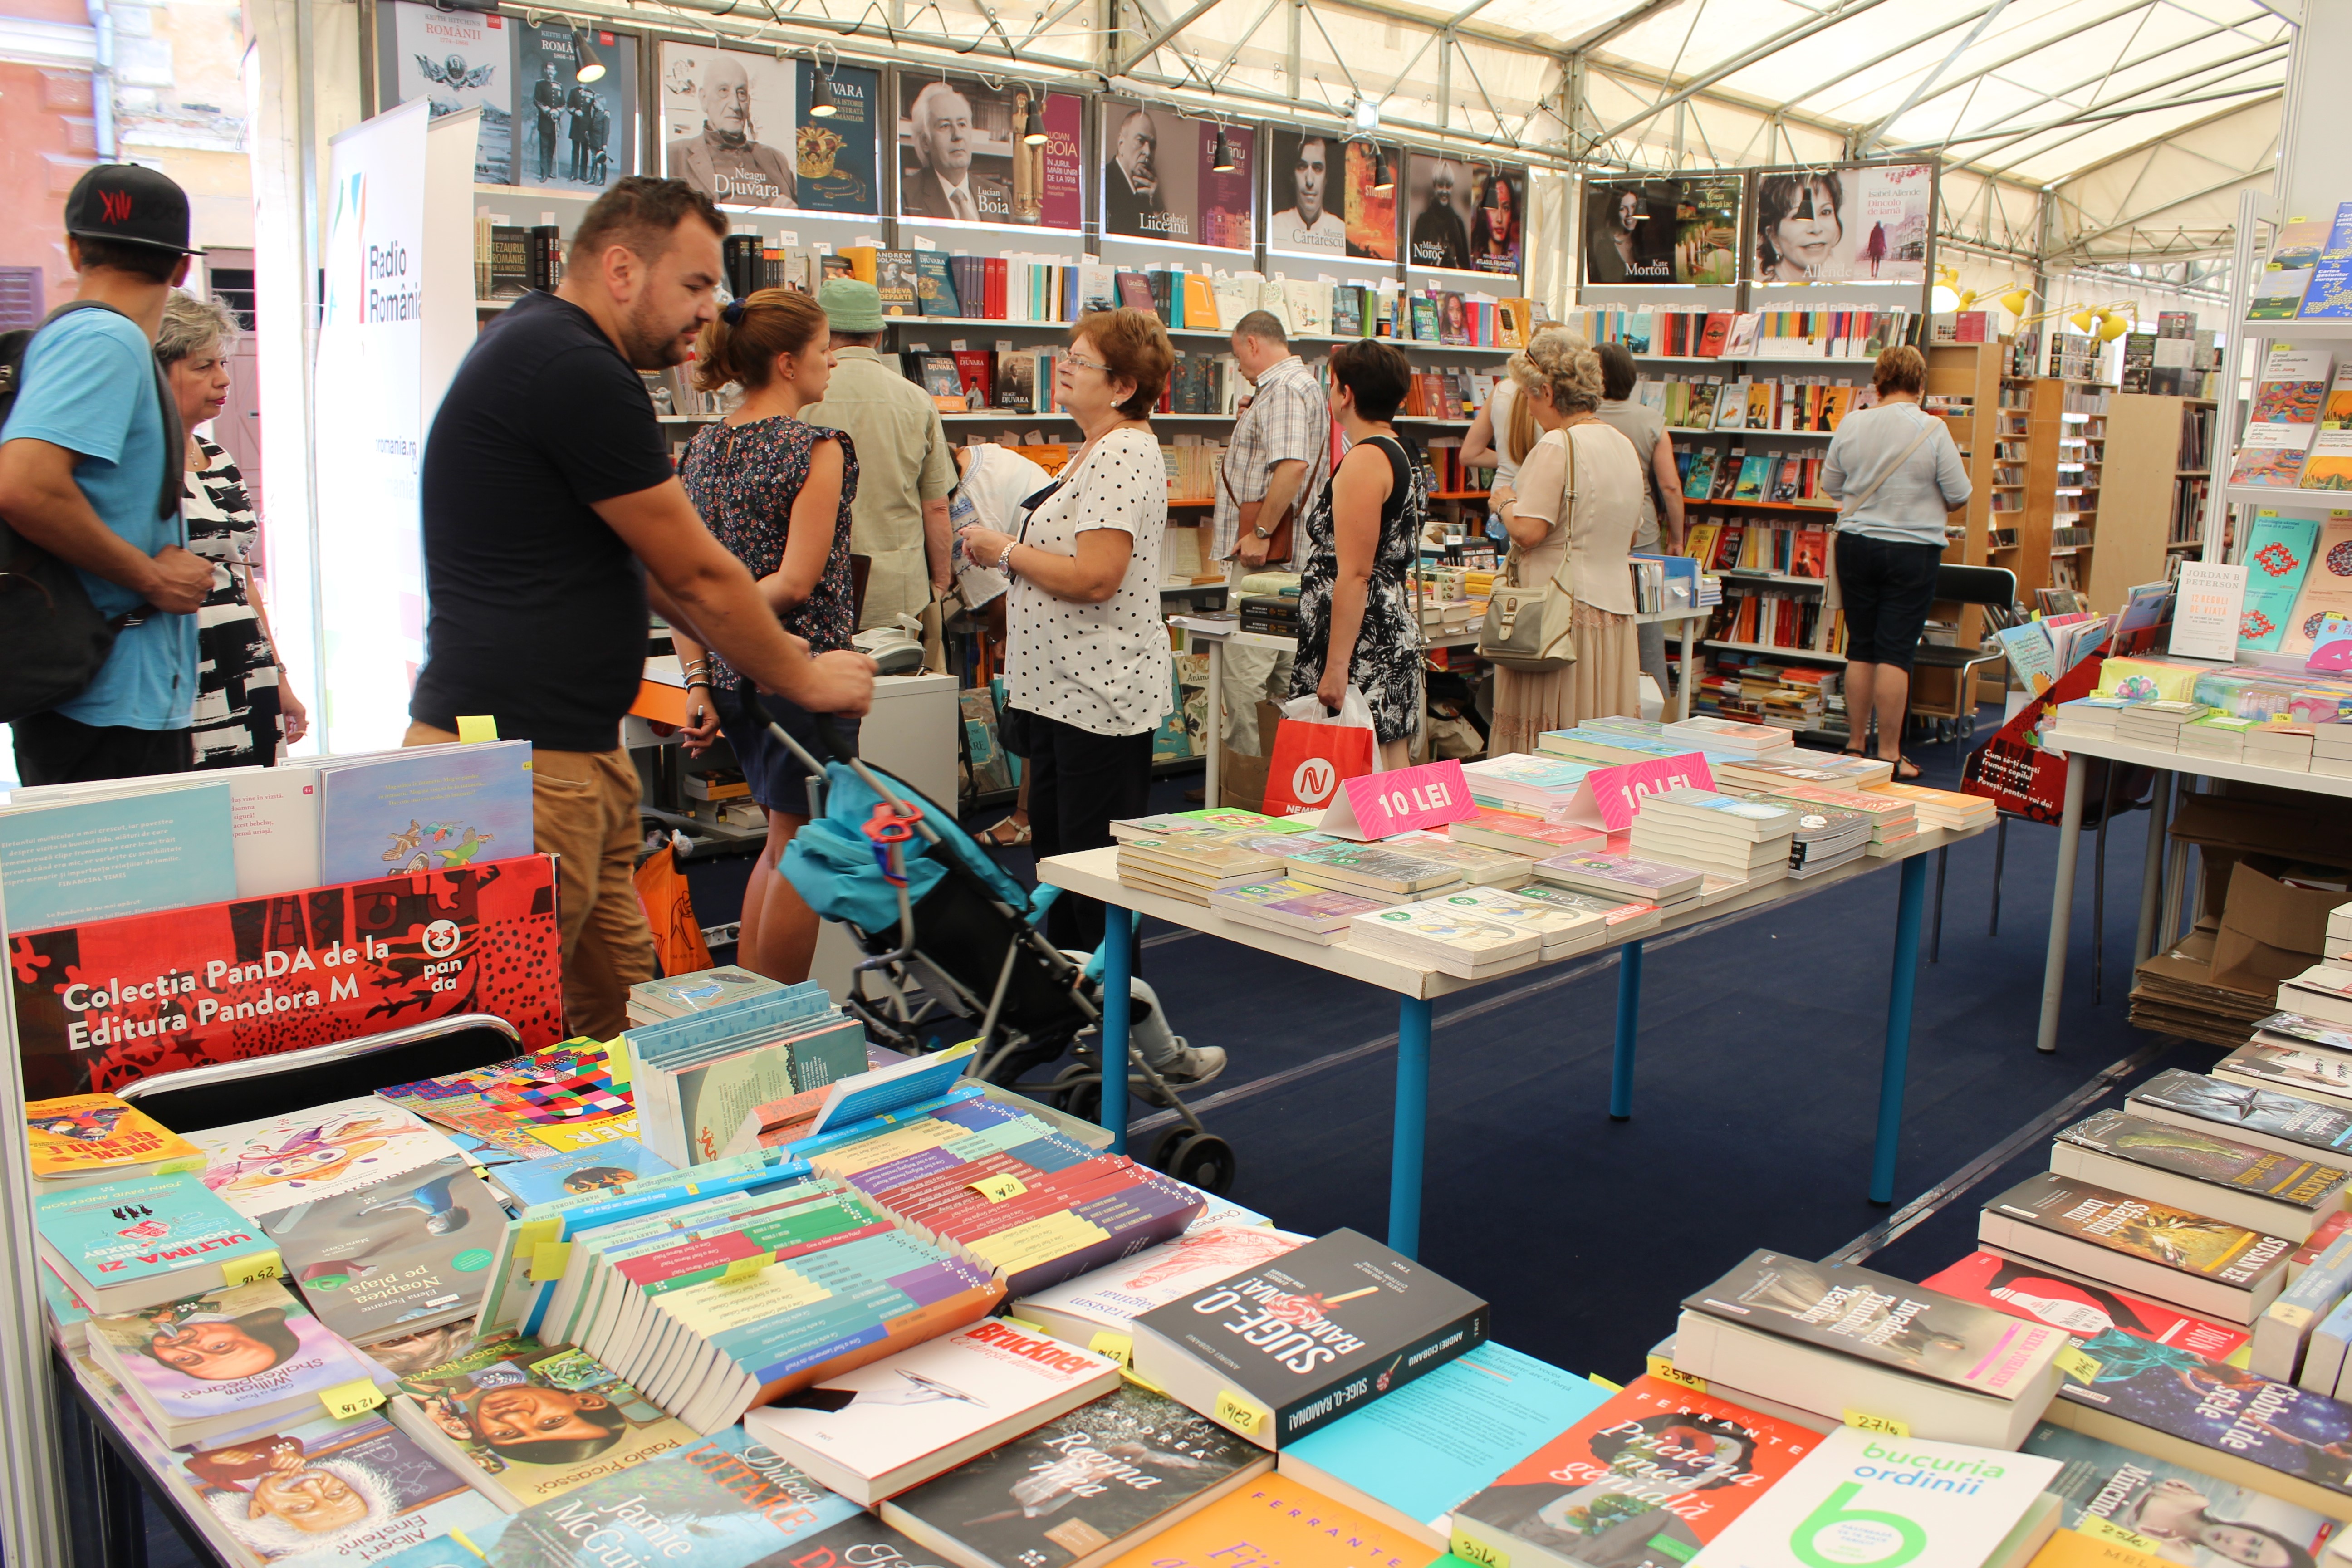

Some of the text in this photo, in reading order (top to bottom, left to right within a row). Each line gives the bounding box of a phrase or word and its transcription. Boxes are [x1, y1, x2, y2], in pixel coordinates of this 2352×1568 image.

[425, 23, 481, 40] ROMÂNII
[541, 30, 560, 39] KEITH
[842, 98, 864, 108] ISTORIE
[1046, 131, 1070, 140] LUCIAN
[1227, 139, 1242, 147] Gabriel
[1046, 142, 1078, 157] BOIA
[1046, 166, 1078, 176] MARII UNIRI
[1054, 159, 1070, 168] JURUL
[714, 173, 781, 200] Djuvara
[735, 167, 766, 184] Neagu
[977, 186, 1000, 197] Lucian
[1705, 187, 1724, 201] Casa
[1868, 188, 1921, 198] Isabel Allende
[1868, 199, 1901, 207] Dincolo
[977, 195, 1009, 215] Boia
[1707, 201, 1723, 210] lângă
[1139, 212, 1189, 235] Liiceanu
[1162, 211, 1188, 225] Gabriel
[1292, 229, 1344, 249] Cărtărescu
[1323, 228, 1343, 239] Mircea
[1422, 240, 1442, 250] Mihaela
[492, 242, 526, 254] TEZAURUL
[493, 253, 526, 265] ROMÂNIEI
[876, 251, 912, 260] ANDREW
[1413, 243, 1444, 260] Noroc
[369, 240, 407, 280] Radio
[919, 257, 946, 265] DJUVARA
[1625, 262, 1670, 276] Morton
[1652, 258, 1668, 268] Kate
[1802, 263, 1852, 278] Allende
[1127, 279, 1147, 288] Liiceanu
[880, 293, 913, 301] DEPARTE
[2185, 578, 2239, 589] PETERSON
[2186, 569, 2231, 580] JORDAN
[2190, 604, 2200, 613] DE
[2191, 594, 2229, 606] 12 REGULI
[1982, 757, 2033, 781] frumos copilul
[1984, 749, 2019, 769] Cum să-ți
[265, 793, 284, 802] vizită.
[1378, 782, 1452, 819] 10 LEI
[1977, 775, 2053, 809] Povești pentru voi doi
[234, 812, 255, 821] sigură!
[1, 837, 36, 848] Elefantul
[37, 832, 75, 843] multicolor
[98, 825, 127, 834] crescut,
[140, 819, 174, 830] povestea
[9, 848, 34, 858] despre
[68, 838, 95, 847] bunicul
[114, 832, 140, 841] alături
[58, 872, 127, 888] FINANCIAL TIMES
[63, 934, 390, 1013] Colecția PanDA de la
[423, 957, 463, 980] pan
[431, 975, 457, 994] da
[68, 972, 360, 1051] Editura Pandora M
[92, 1138, 164, 1159] JACK
[112, 1187, 146, 1199] DAVID
[149, 1180, 182, 1194] JOHN
[2287, 1166, 2344, 1202] BRACKEN
[41, 1195, 108, 1212] ANDERSON
[2061, 1196, 2115, 1222] lumii
[84, 1244, 142, 1259] BIXBY
[97, 1234, 253, 1274] ULTIMA ZI
[322, 1237, 369, 1254] Mara Cerri
[1390, 1260, 1410, 1274] TREI
[2218, 1235, 2289, 1284] SUSAN EE
[347, 1264, 429, 1295] pe plajă
[353, 1276, 443, 1304] Noaptea
[361, 1289, 437, 1313] Elena Ferrante
[1790, 1285, 1861, 1325] Tearling
[1192, 1285, 1336, 1374] SUGE-O,
[1859, 1298, 1930, 1346] Invadarea
[1408, 1330, 1464, 1367] ANDREI CIOBANU
[2184, 1322, 2234, 1353] JOHN
[462, 1342, 517, 1364] Isaac
[950, 1336, 1074, 1383] Ce domnul?
[1185, 1334, 1241, 1370] ANDREI CIOBANU
[1987, 1328, 2049, 1387] ERIKA JOHANSEN
[181, 1357, 324, 1400] Shakespeare?
[225, 1374, 293, 1396] William
[1334, 1377, 1368, 1408] SUGE-O,
[2194, 1384, 2240, 1419] stele
[1289, 1394, 1334, 1431] RAMONA!
[1636, 1392, 1804, 1455] FERRANTE
[1681, 1394, 1776, 1432] ELENA
[1103, 1409, 1206, 1460] ANDREA
[2219, 1428, 2264, 1451] de
[1043, 1431, 1162, 1490] Regina
[1597, 1418, 1765, 1488] Prietena
[1862, 1442, 2006, 1480] bucuria
[534, 1437, 682, 1495] Pablo Picasso?
[735, 1444, 822, 1504] Dulcea
[1616, 1452, 1702, 1491] mea
[686, 1441, 817, 1535] UITARE
[1029, 1460, 1108, 1498] mea
[1853, 1465, 1985, 1496] ordinii
[1548, 1460, 1715, 1522] genială
[337, 1514, 428, 1557] Einstein?
[598, 1494, 694, 1560] Jamie
[1251, 1491, 1403, 1568] FERRANTE
[358, 1529, 427, 1563] Albert
